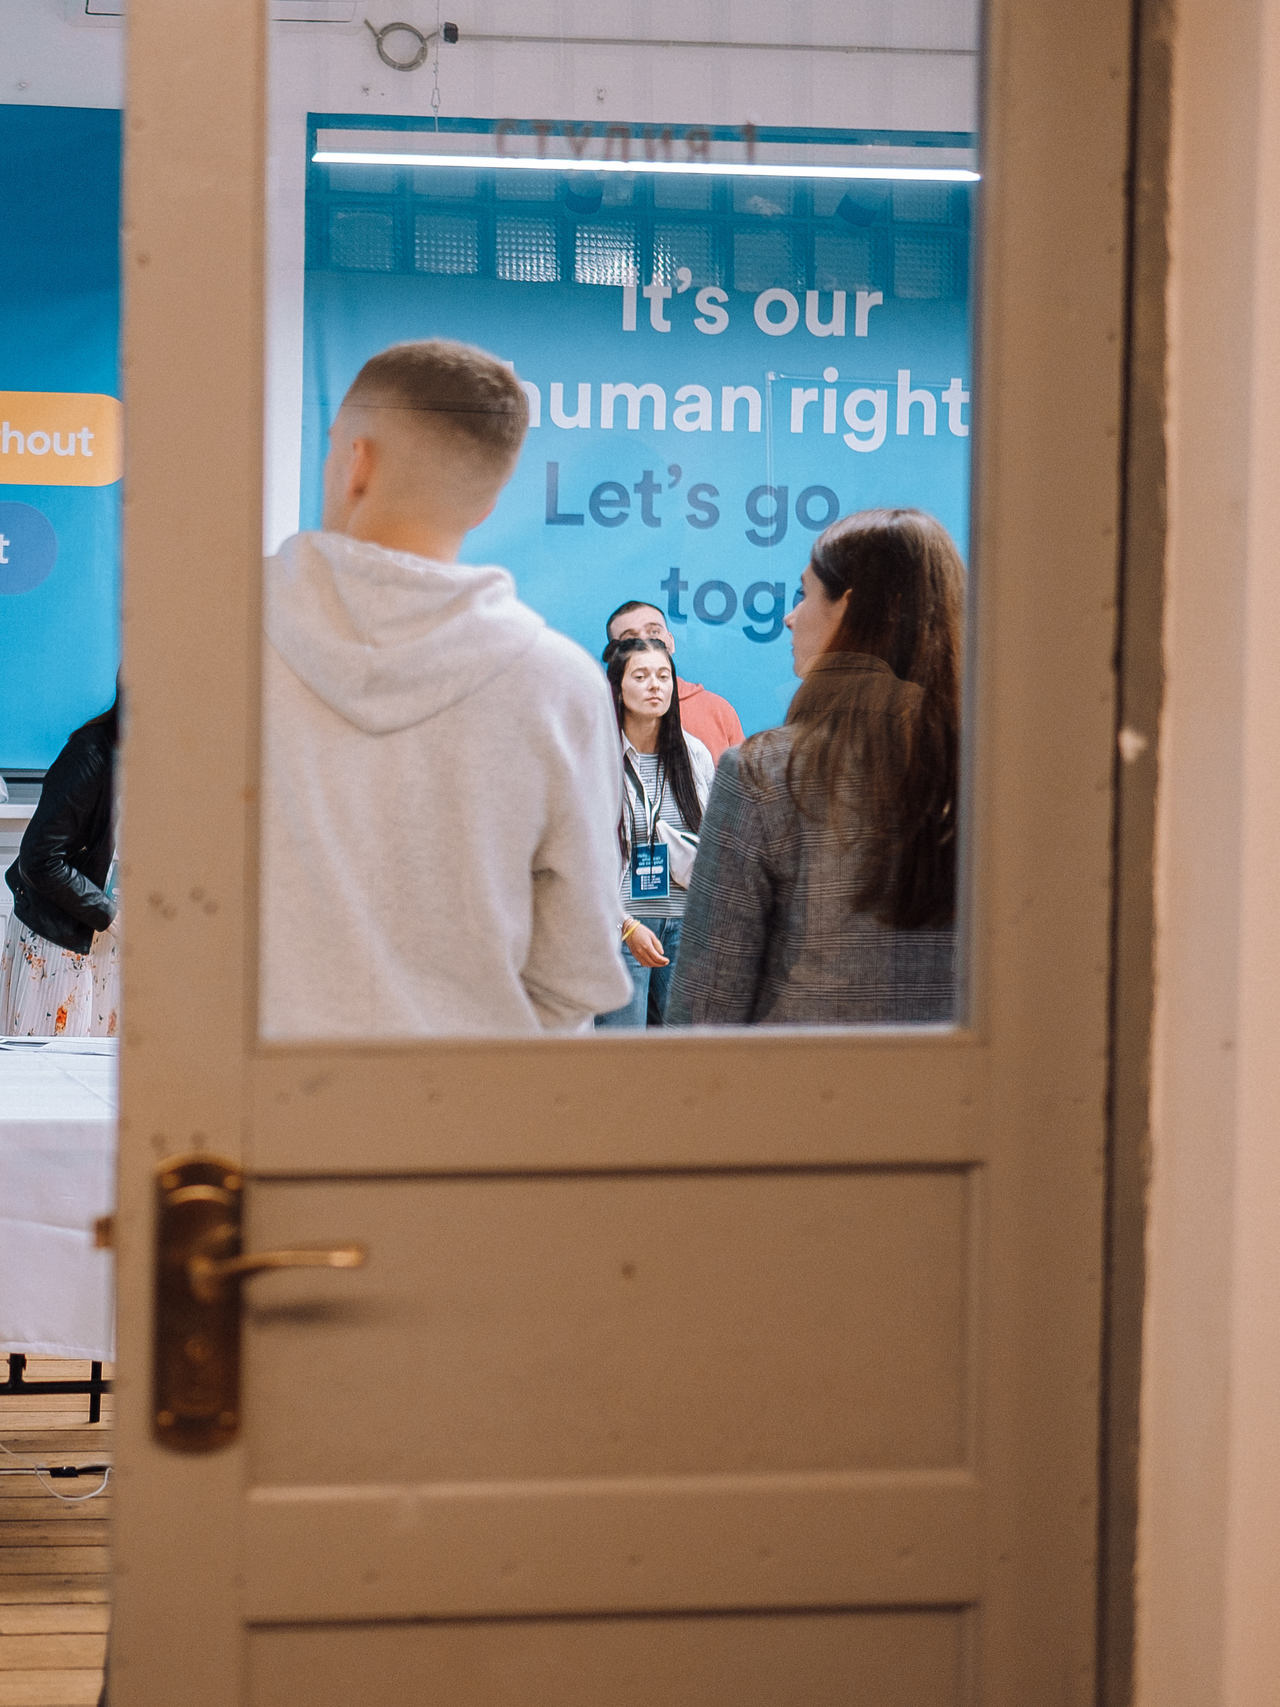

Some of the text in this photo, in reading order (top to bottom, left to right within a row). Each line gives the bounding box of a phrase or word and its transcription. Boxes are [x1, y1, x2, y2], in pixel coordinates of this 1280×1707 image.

[495, 118, 711, 163] СТУДИЯ
[622, 266, 884, 337] It’s our
[790, 366, 970, 453] right
[545, 461, 840, 547] Let’s go
[660, 567, 806, 644] tog
